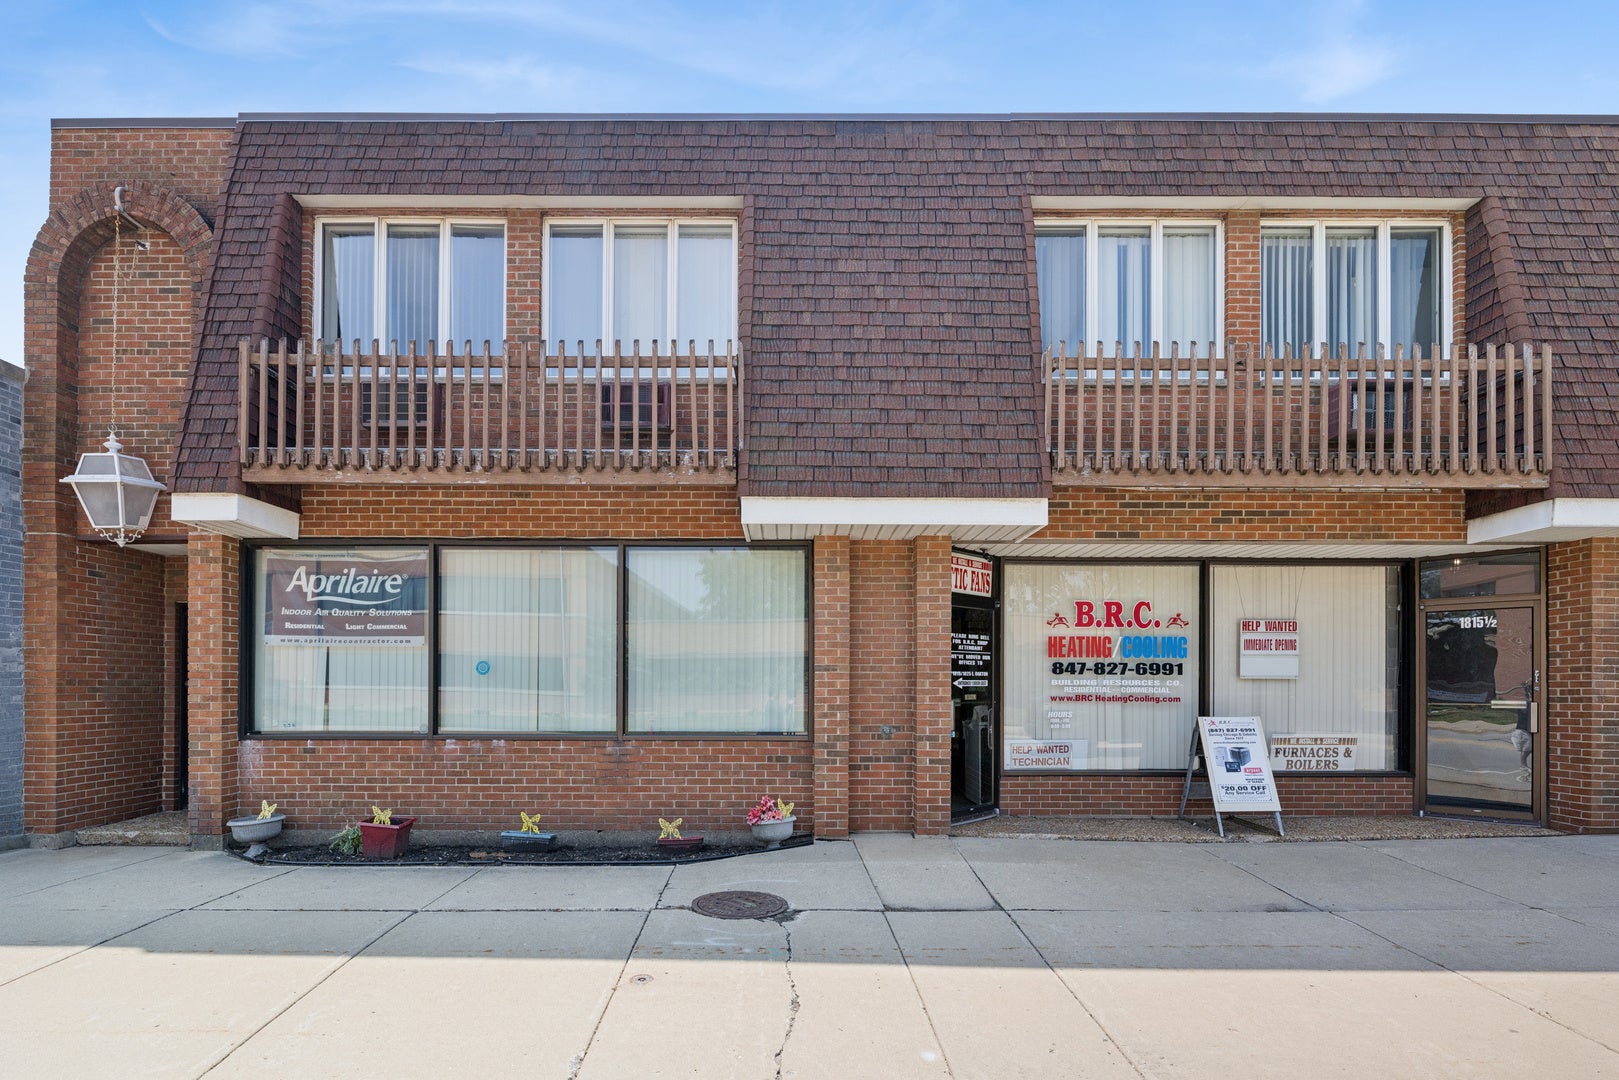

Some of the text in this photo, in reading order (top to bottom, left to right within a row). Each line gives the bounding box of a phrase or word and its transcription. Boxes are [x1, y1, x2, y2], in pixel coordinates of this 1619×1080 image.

[285, 565, 403, 602] Aprilaire
[970, 570, 991, 594] FANS
[1074, 600, 1161, 629] B.R.C.
[1241, 620, 1298, 632] HELP WANTED
[280, 637, 412, 645] www.aprilairecontractor.com
[1243, 638, 1297, 651] IMMEDIATE OPENING
[1051, 661, 1184, 676] 847-827-6991
[1121, 686, 1171, 694] COMMERCIAL
[1012, 744, 1070, 755] HELP WANTED
[1274, 747, 1353, 758] FURNACES &
[1012, 757, 1070, 767] TECHNICIAN
[1285, 759, 1339, 770] BOILERS
